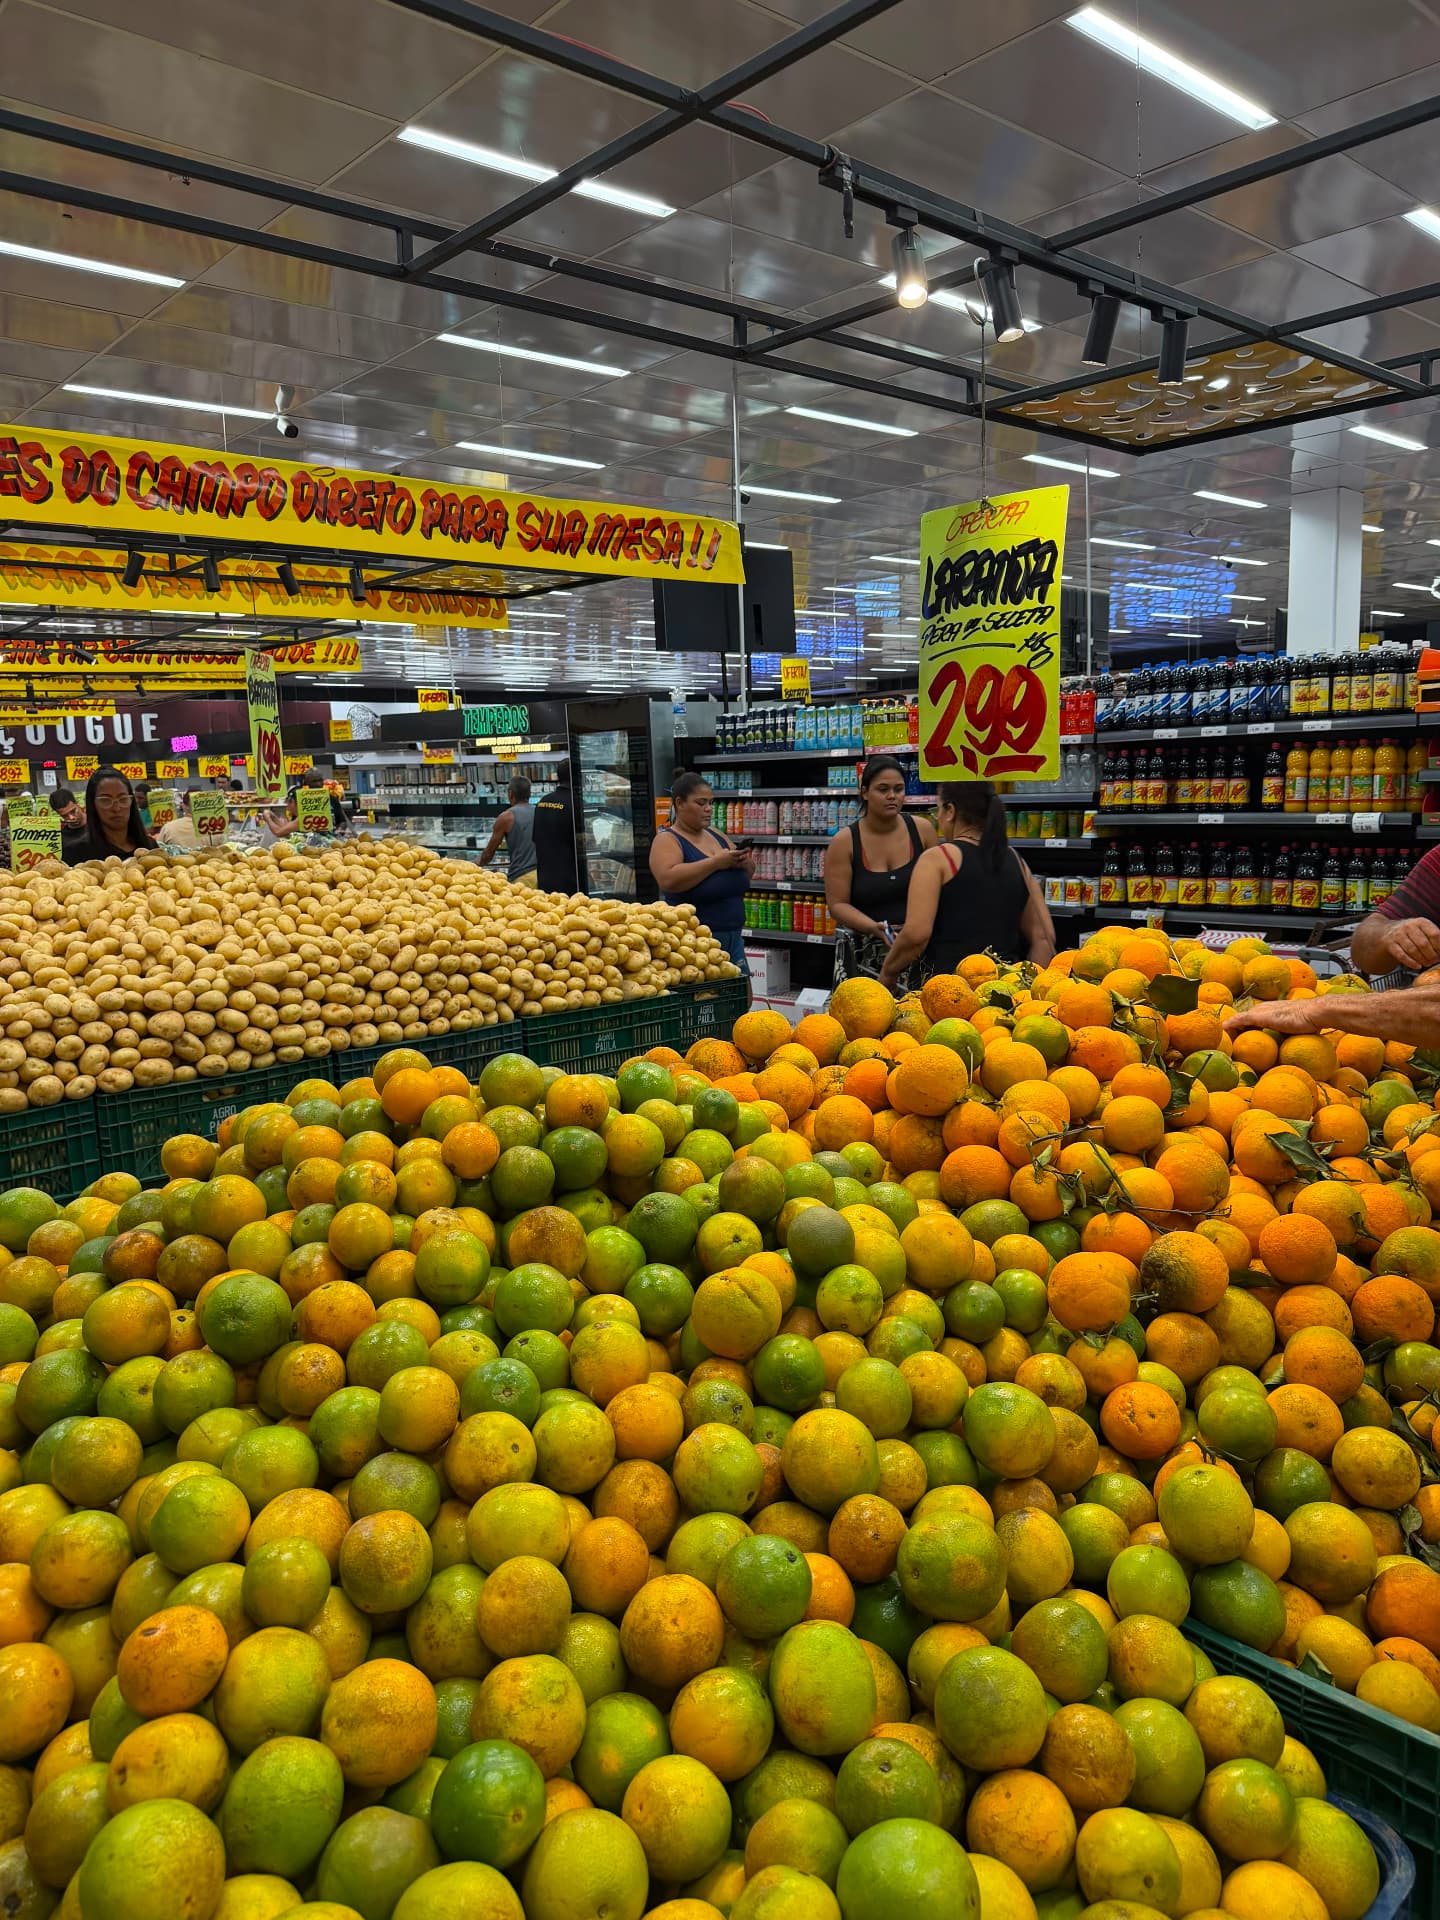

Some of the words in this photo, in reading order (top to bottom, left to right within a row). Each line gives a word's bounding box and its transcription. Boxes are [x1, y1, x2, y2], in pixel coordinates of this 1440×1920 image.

[59, 445, 120, 506] DO
[126, 450, 287, 522] CAMPO
[290, 467, 416, 536] DIRETO
[420, 487, 509, 550] PARA
[516, 500, 588, 559] SUA
[946, 500, 1030, 542] OFERTA
[982, 605, 1056, 633] SELETA
[462, 705, 529, 736] TEMPEROS
[12, 828, 62, 841] TOMATE
[213, 1104, 237, 1119] AGRO
